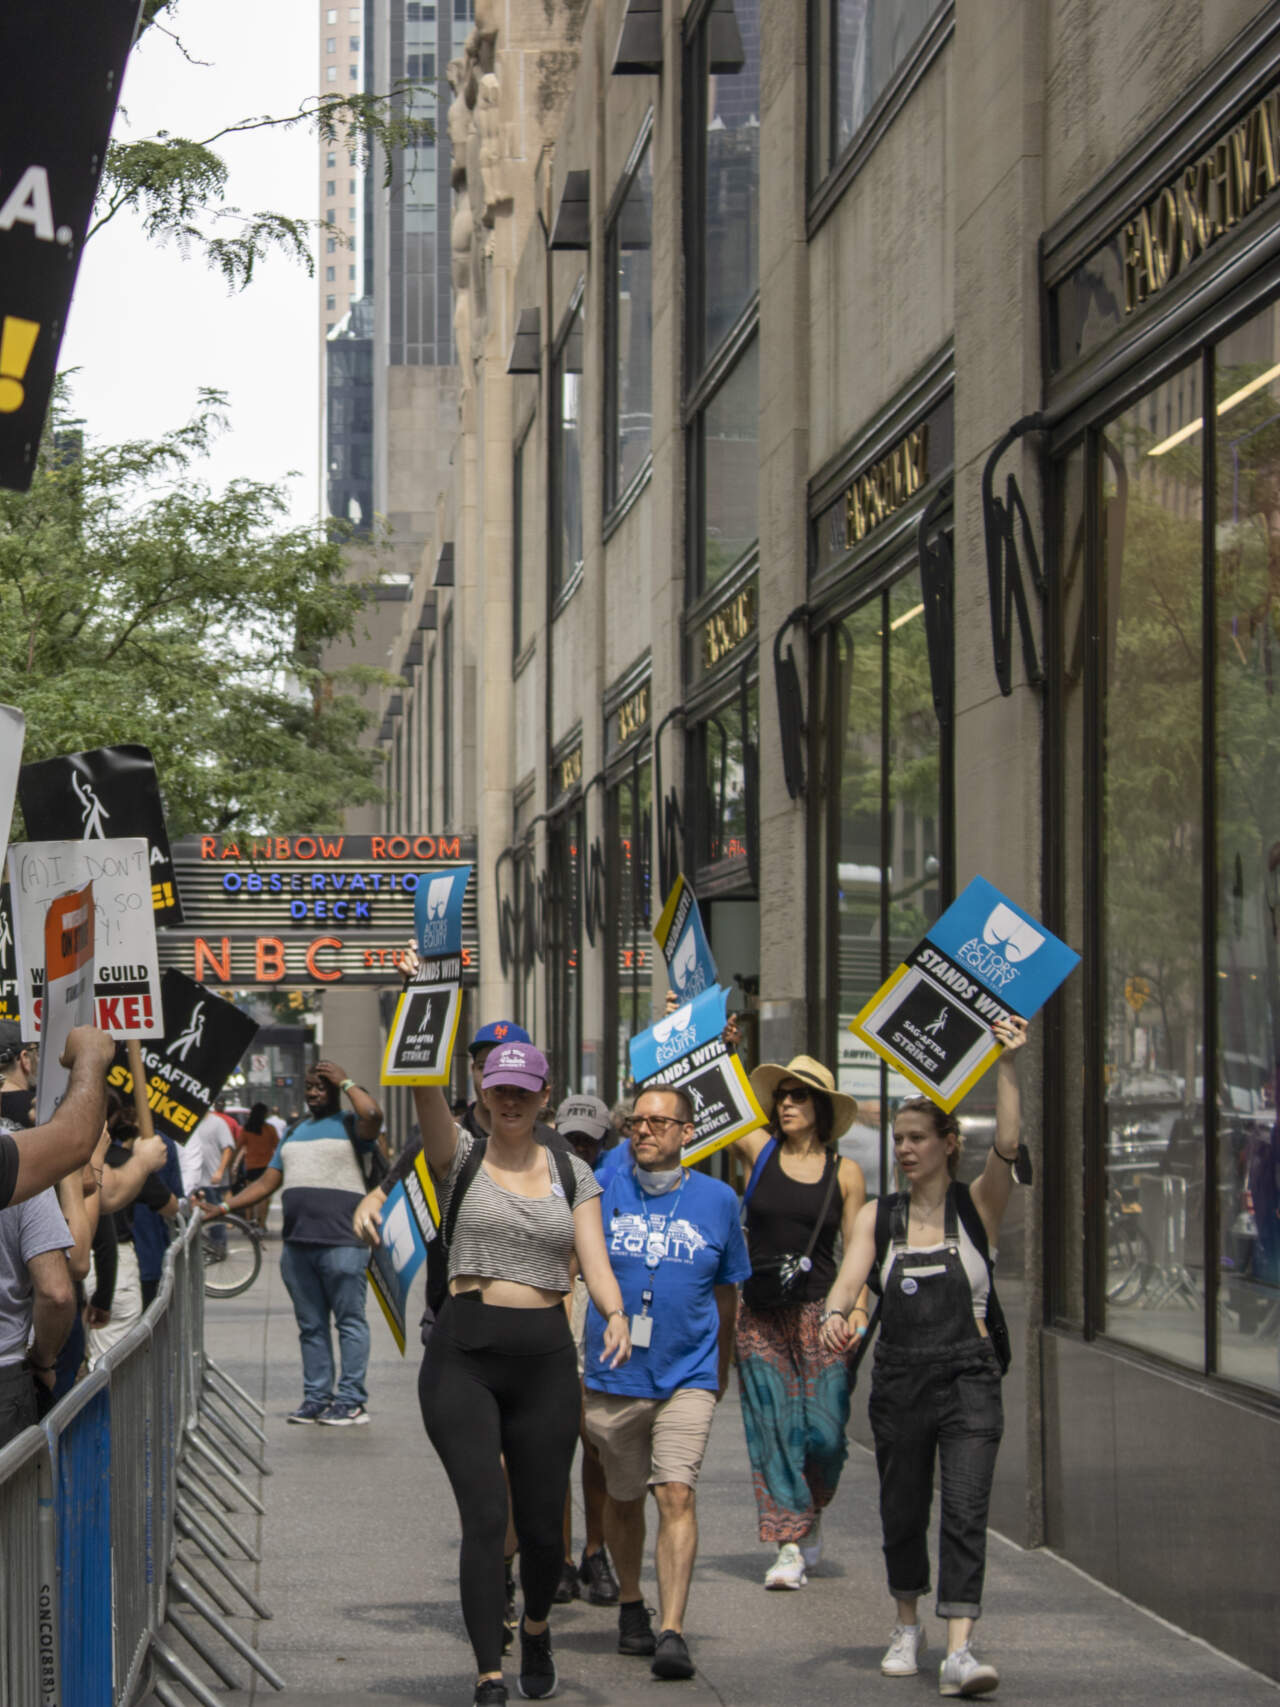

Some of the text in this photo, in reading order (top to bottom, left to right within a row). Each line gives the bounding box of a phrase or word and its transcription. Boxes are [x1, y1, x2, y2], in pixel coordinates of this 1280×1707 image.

[1183, 92, 1280, 264] SCHWA
[201, 836, 461, 859] RANBOW ROOM
[223, 873, 419, 891] OBSERVATIO
[290, 900, 370, 919] DECK
[194, 936, 344, 982] NBC
[957, 943, 1011, 988] EQUITY
[99, 964, 149, 982] GUILD
[917, 948, 978, 999] STANDS
[974, 993, 1011, 1023] WIT
[691, 1040, 727, 1067] WITH
[892, 1032, 938, 1072] STRIKE!
[150, 1076, 170, 1094] ON
